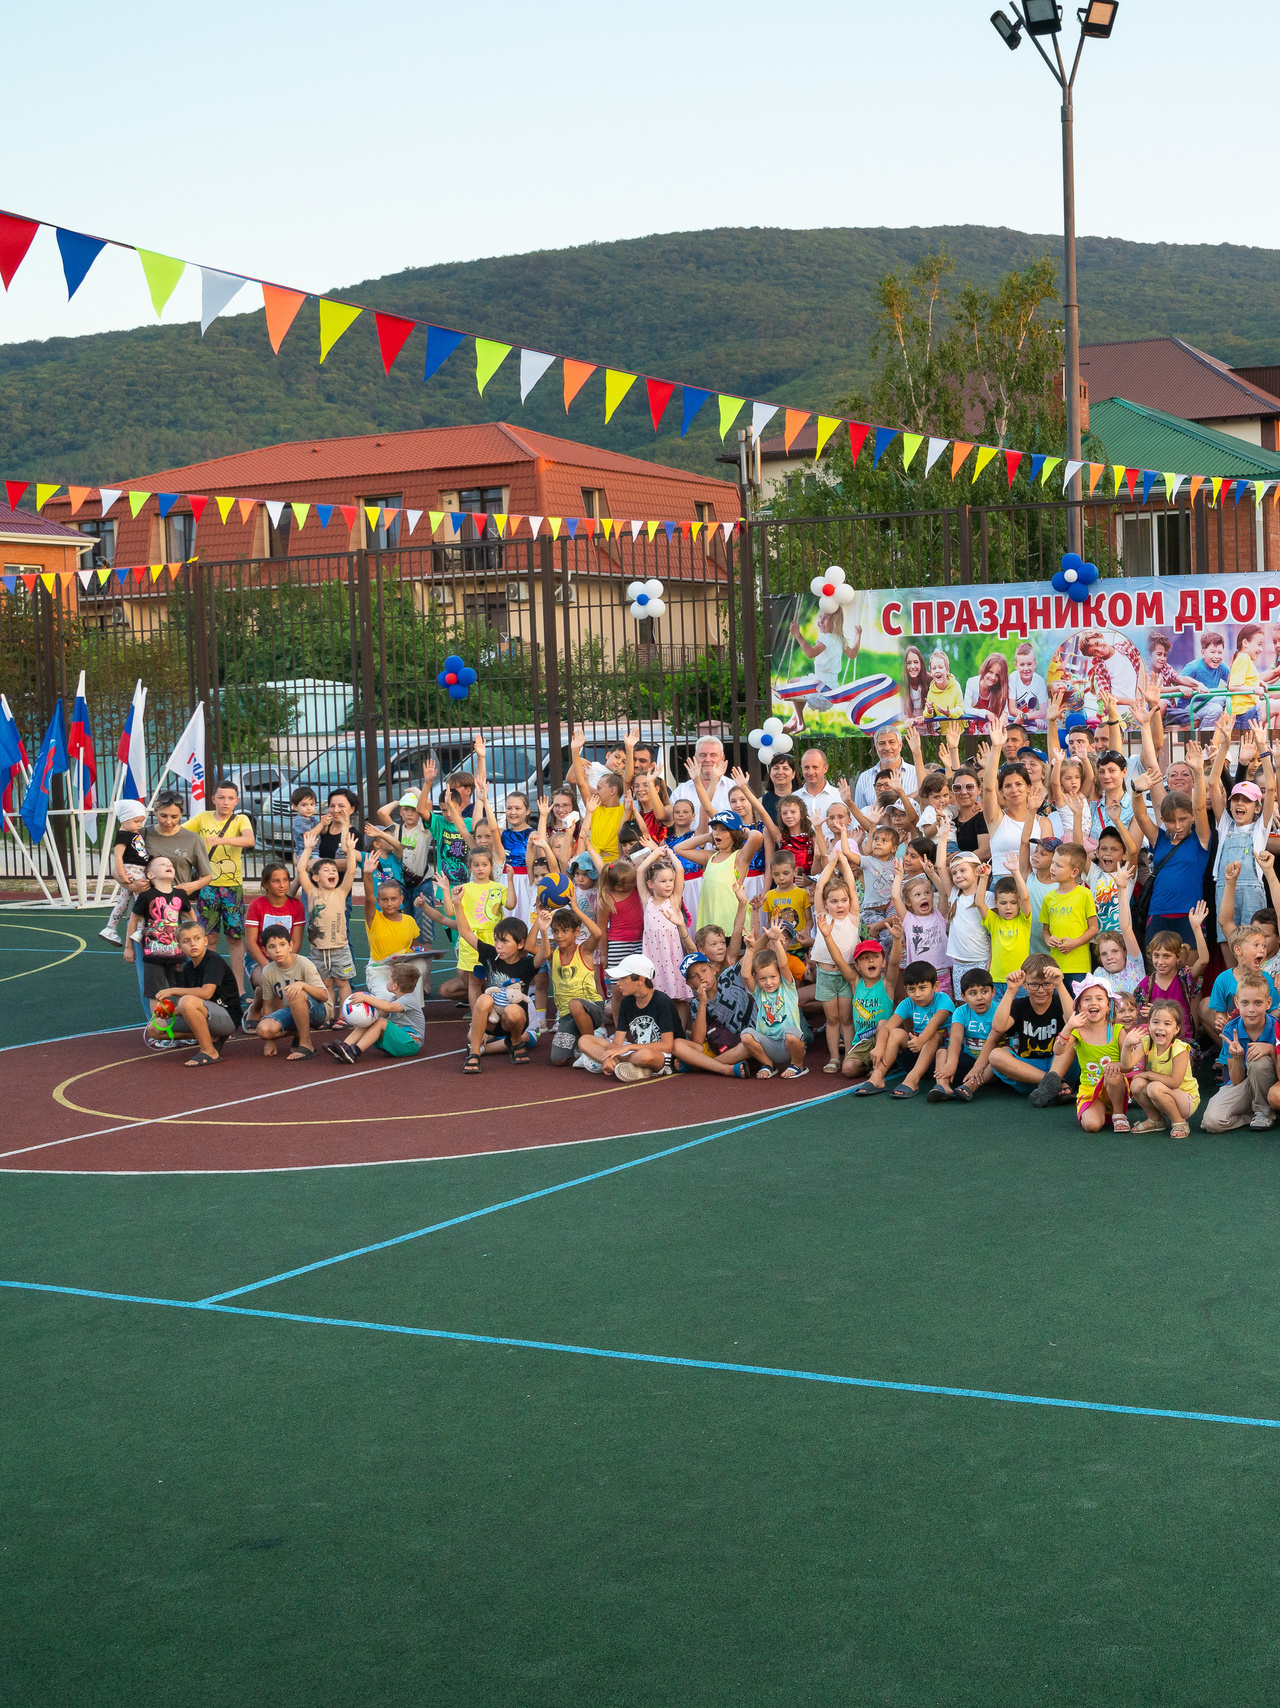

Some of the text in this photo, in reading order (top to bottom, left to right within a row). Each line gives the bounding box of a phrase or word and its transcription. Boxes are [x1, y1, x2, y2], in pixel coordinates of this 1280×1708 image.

[881, 602, 903, 637] С
[912, 591, 1165, 639] ПРАЗДНИКОМ
[773, 897, 792, 906] BORN
[1023, 1018, 1057, 1041] КИНО
